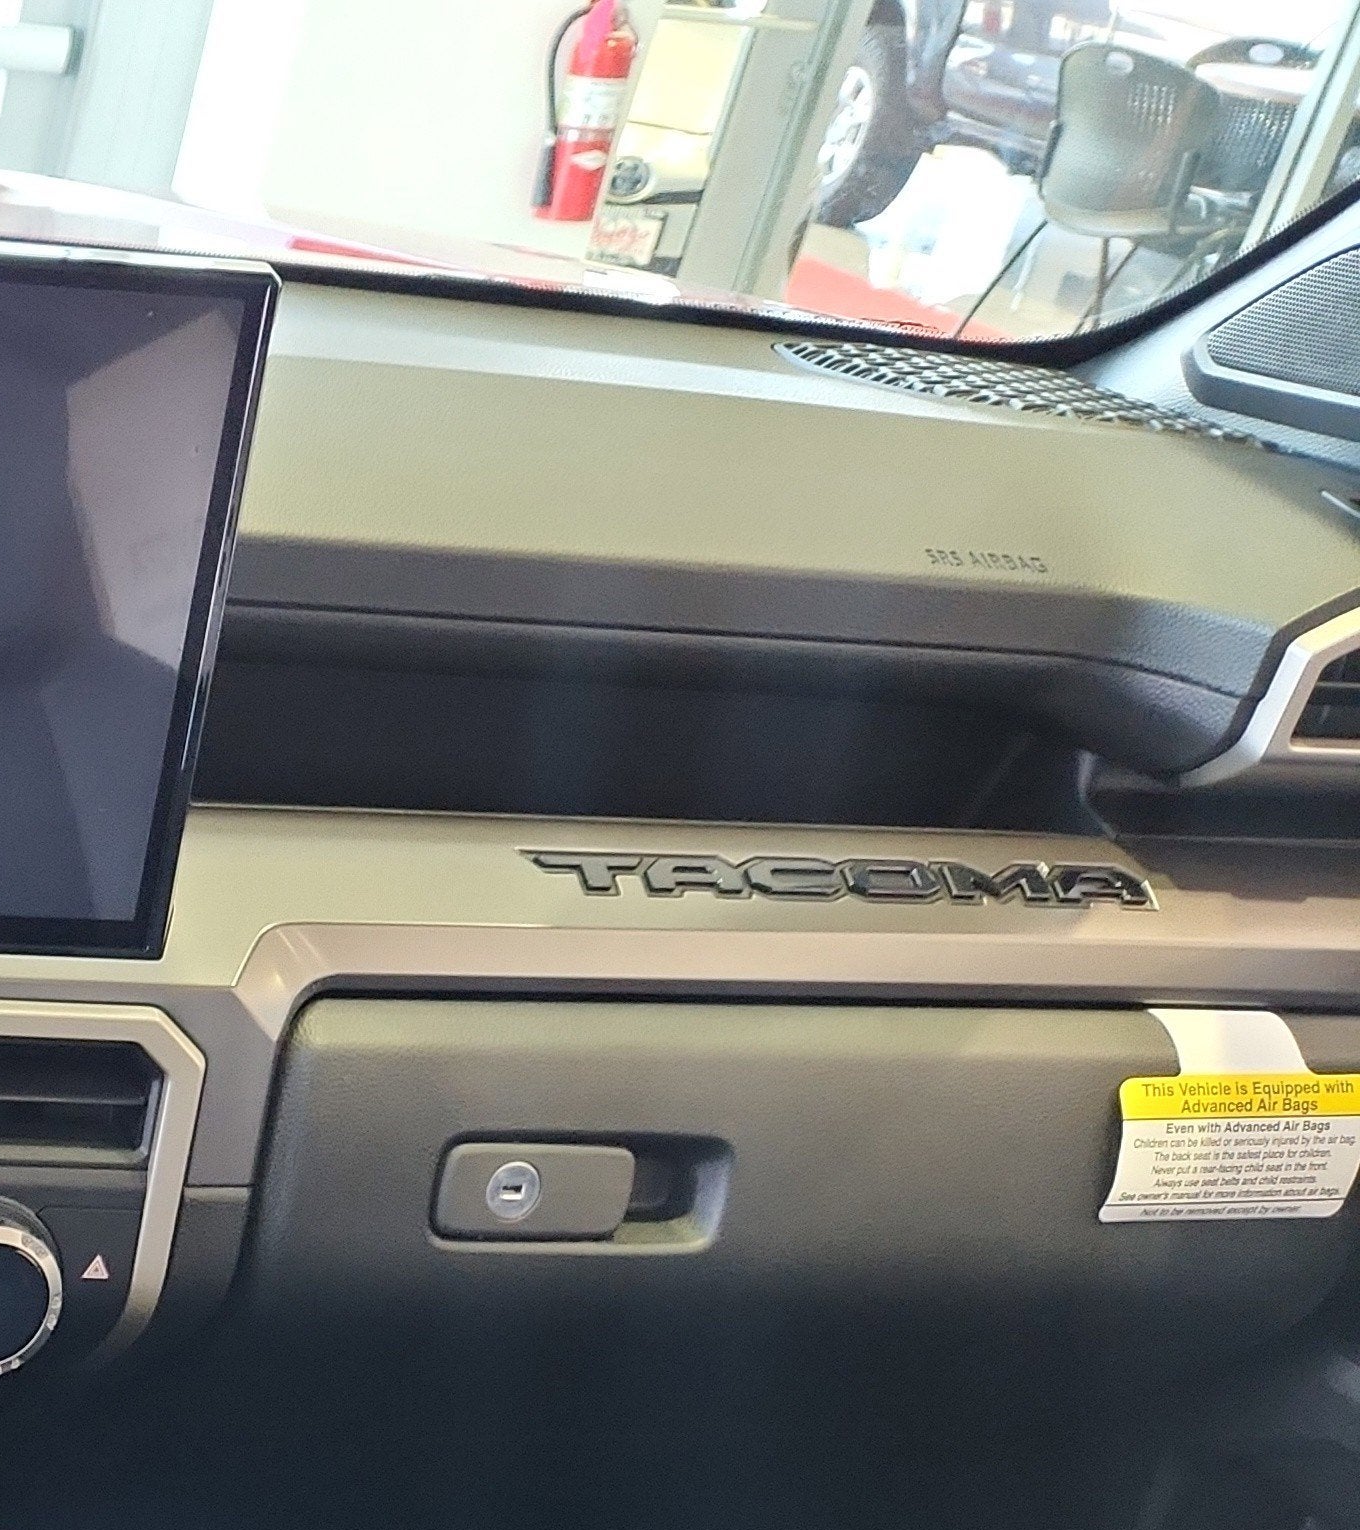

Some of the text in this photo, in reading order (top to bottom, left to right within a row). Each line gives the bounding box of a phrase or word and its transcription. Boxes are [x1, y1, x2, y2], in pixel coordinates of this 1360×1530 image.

[925, 548, 1048, 573] SRS AIRBAG
[516, 847, 1160, 912] TACOMA
[1141, 1083, 1175, 1097] This
[1178, 1081, 1231, 1097] Vehicle
[1251, 1081, 1320, 1100] Equipped
[1324, 1080, 1354, 1094] with
[1181, 1097, 1319, 1115] Advanced Air Bags
[1165, 1119, 1331, 1135] Even with Advanced Air Bags
[1133, 1138, 1168, 1149] Children
[1170, 1140, 1186, 1148] can
[1187, 1138, 1198, 1148] be
[1200, 1137, 1221, 1147] killed
[1233, 1138, 1270, 1148] seriously
[1272, 1135, 1300, 1147] injured
[1301, 1136, 1310, 1147] by
[1154, 1151, 1170, 1161] The
[1172, 1151, 1191, 1161] back
[1193, 1152, 1211, 1161] seat
[1222, 1151, 1235, 1160] the
[1151, 1165, 1176, 1175] Never
[1176, 1165, 1191, 1176] put
[1244, 1163, 1264, 1173] child
[1153, 1178, 1183, 1190] Always
[1120, 1192, 1136, 1201] See
